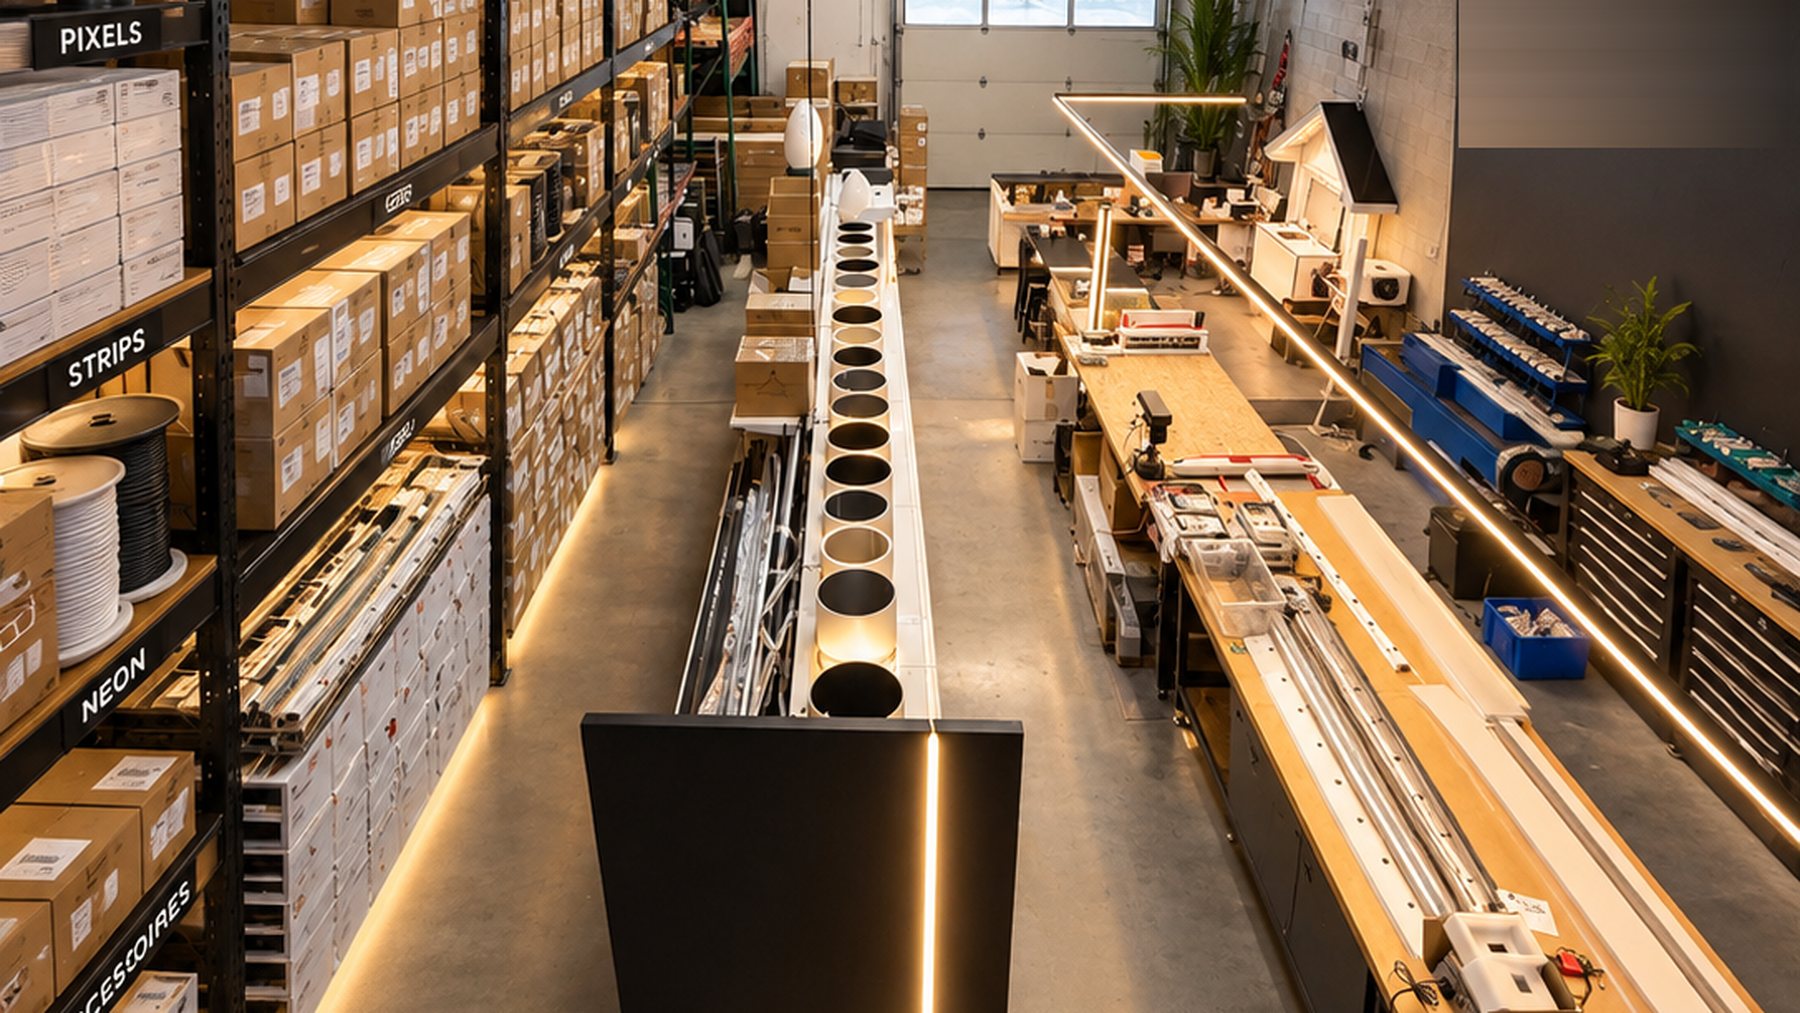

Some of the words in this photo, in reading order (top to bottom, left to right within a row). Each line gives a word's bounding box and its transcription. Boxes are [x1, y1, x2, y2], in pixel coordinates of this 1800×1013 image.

[61, 21, 142, 54] PIXELS
[68, 328, 145, 388] STRIPS
[82, 647, 145, 723] NEON
[80, 881, 190, 1013] CESSOIRES
